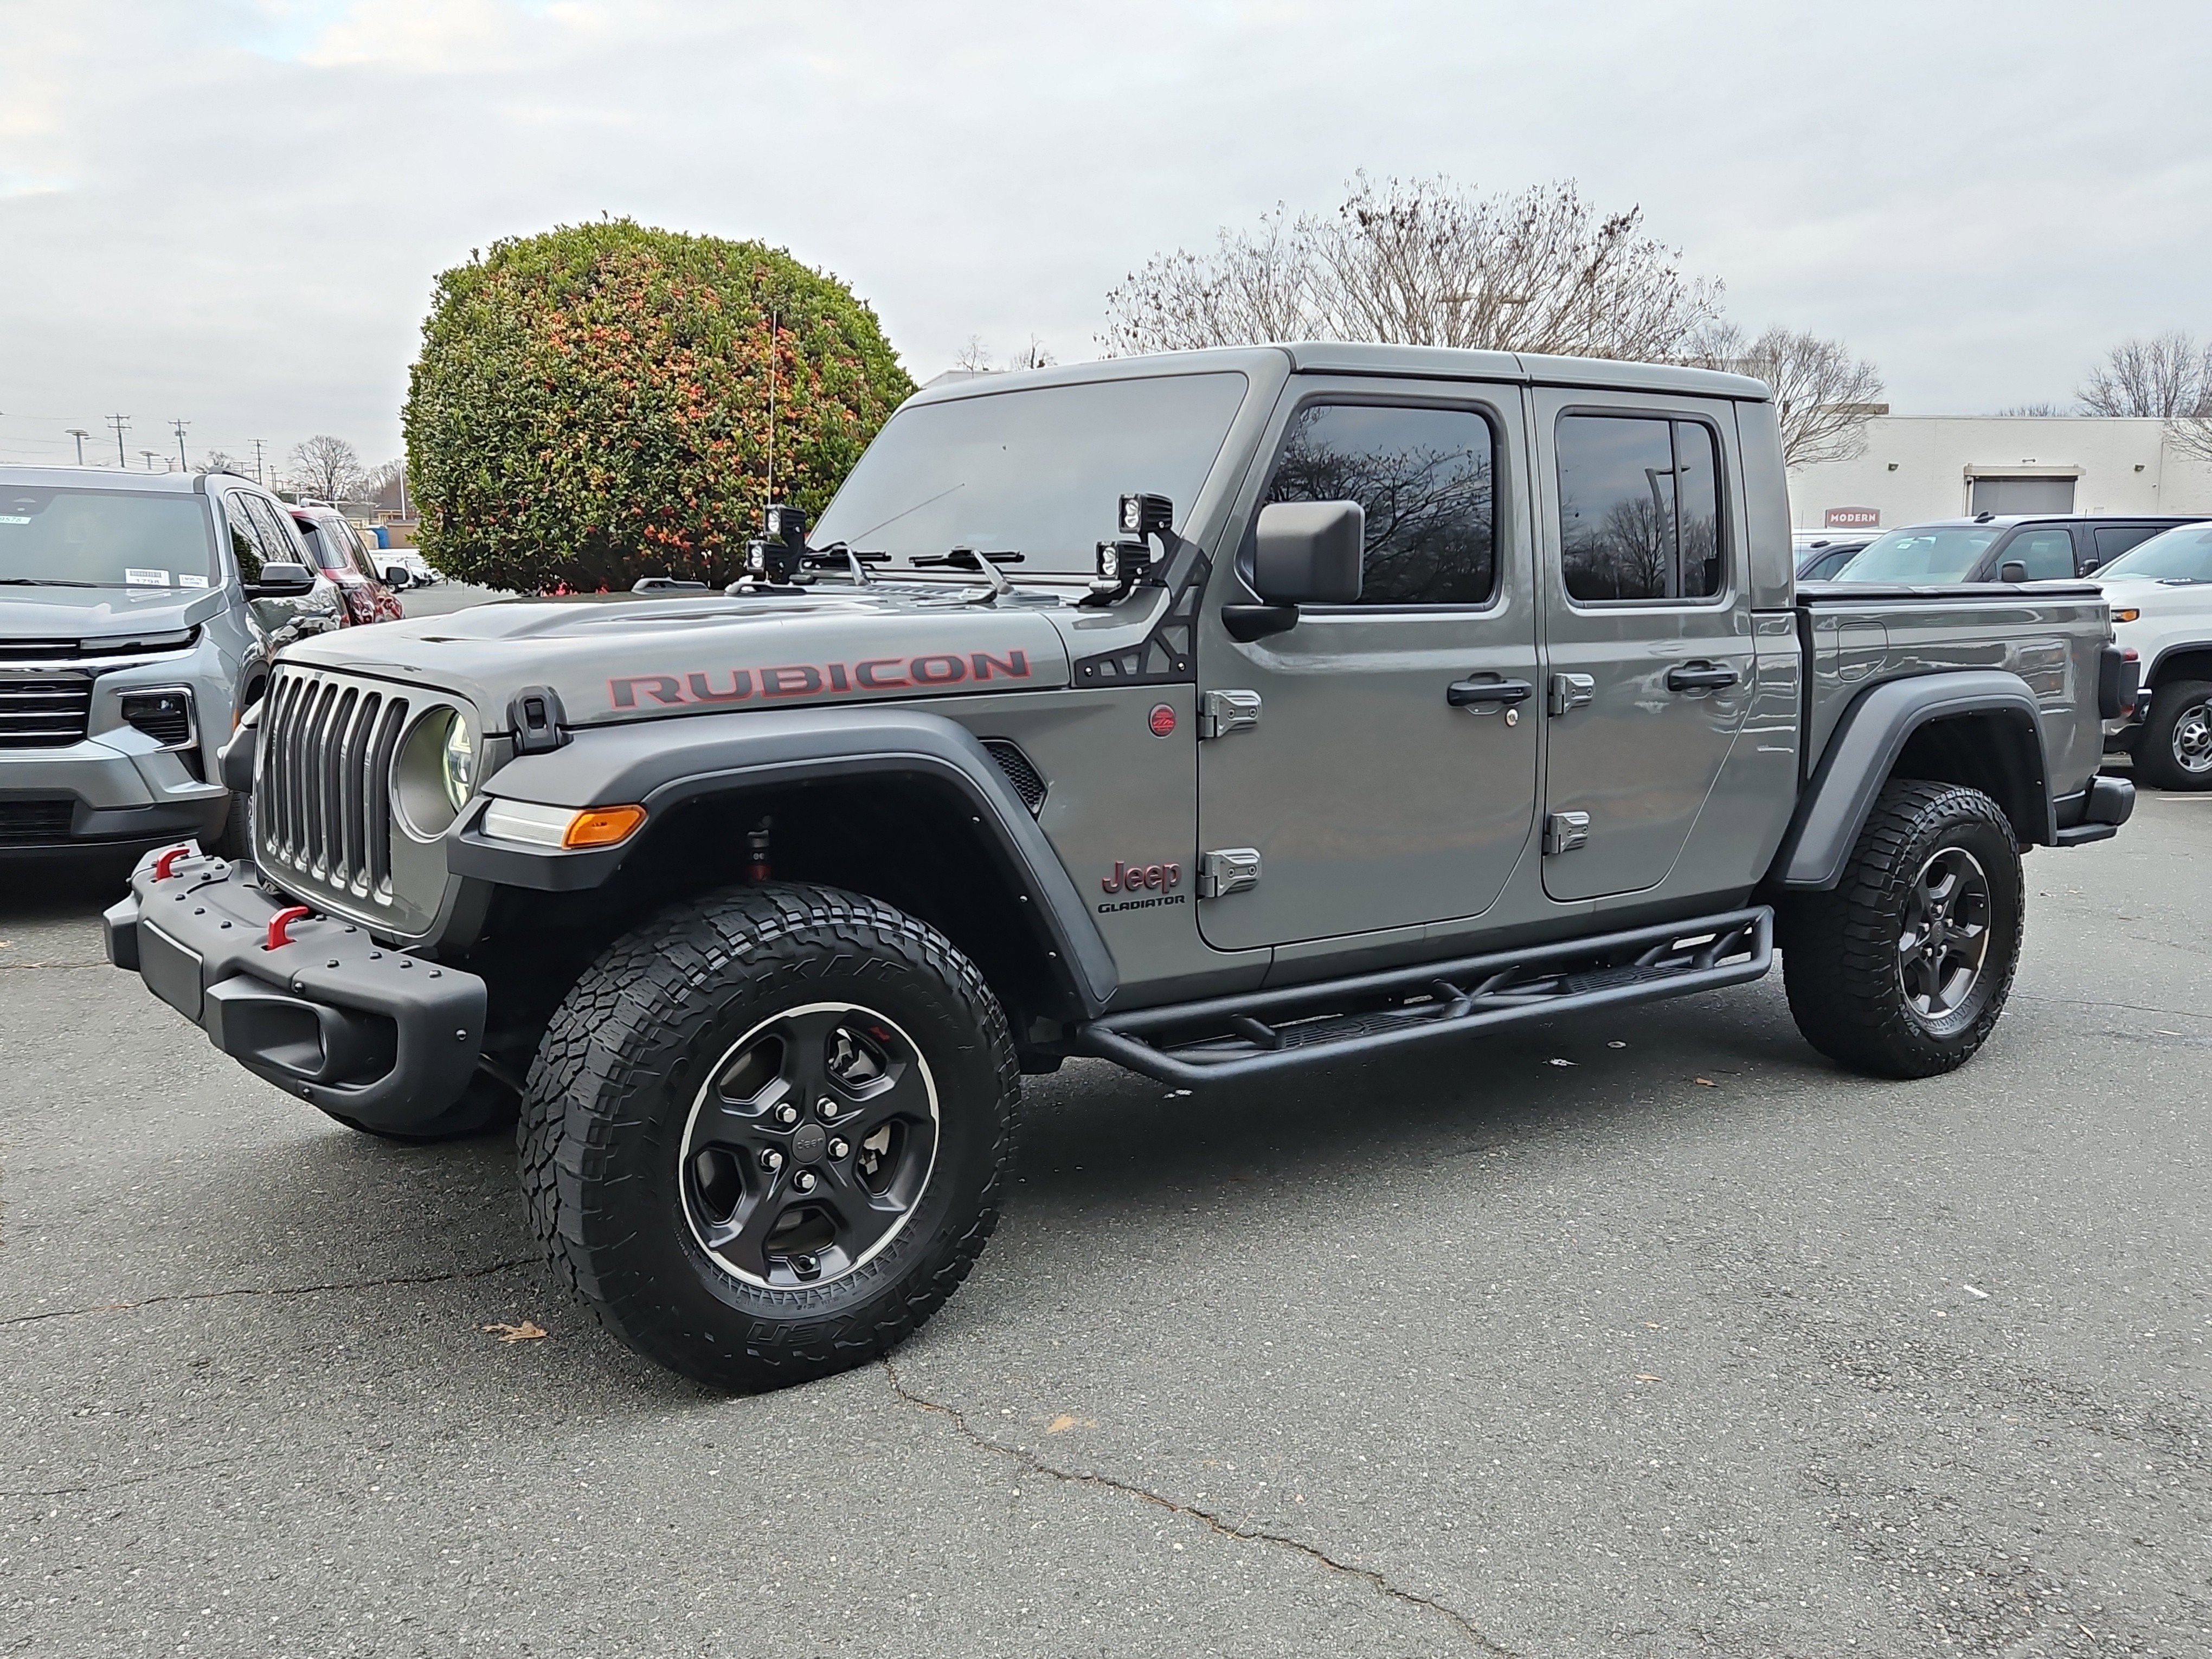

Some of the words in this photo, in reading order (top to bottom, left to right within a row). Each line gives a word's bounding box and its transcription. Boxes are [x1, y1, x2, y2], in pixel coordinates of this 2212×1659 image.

[1830, 513, 1876, 522] MODERN
[606, 650, 1031, 710] RUBICON
[1102, 860, 1182, 893] Jeep
[1097, 895, 1186, 914] GLADIATOR
